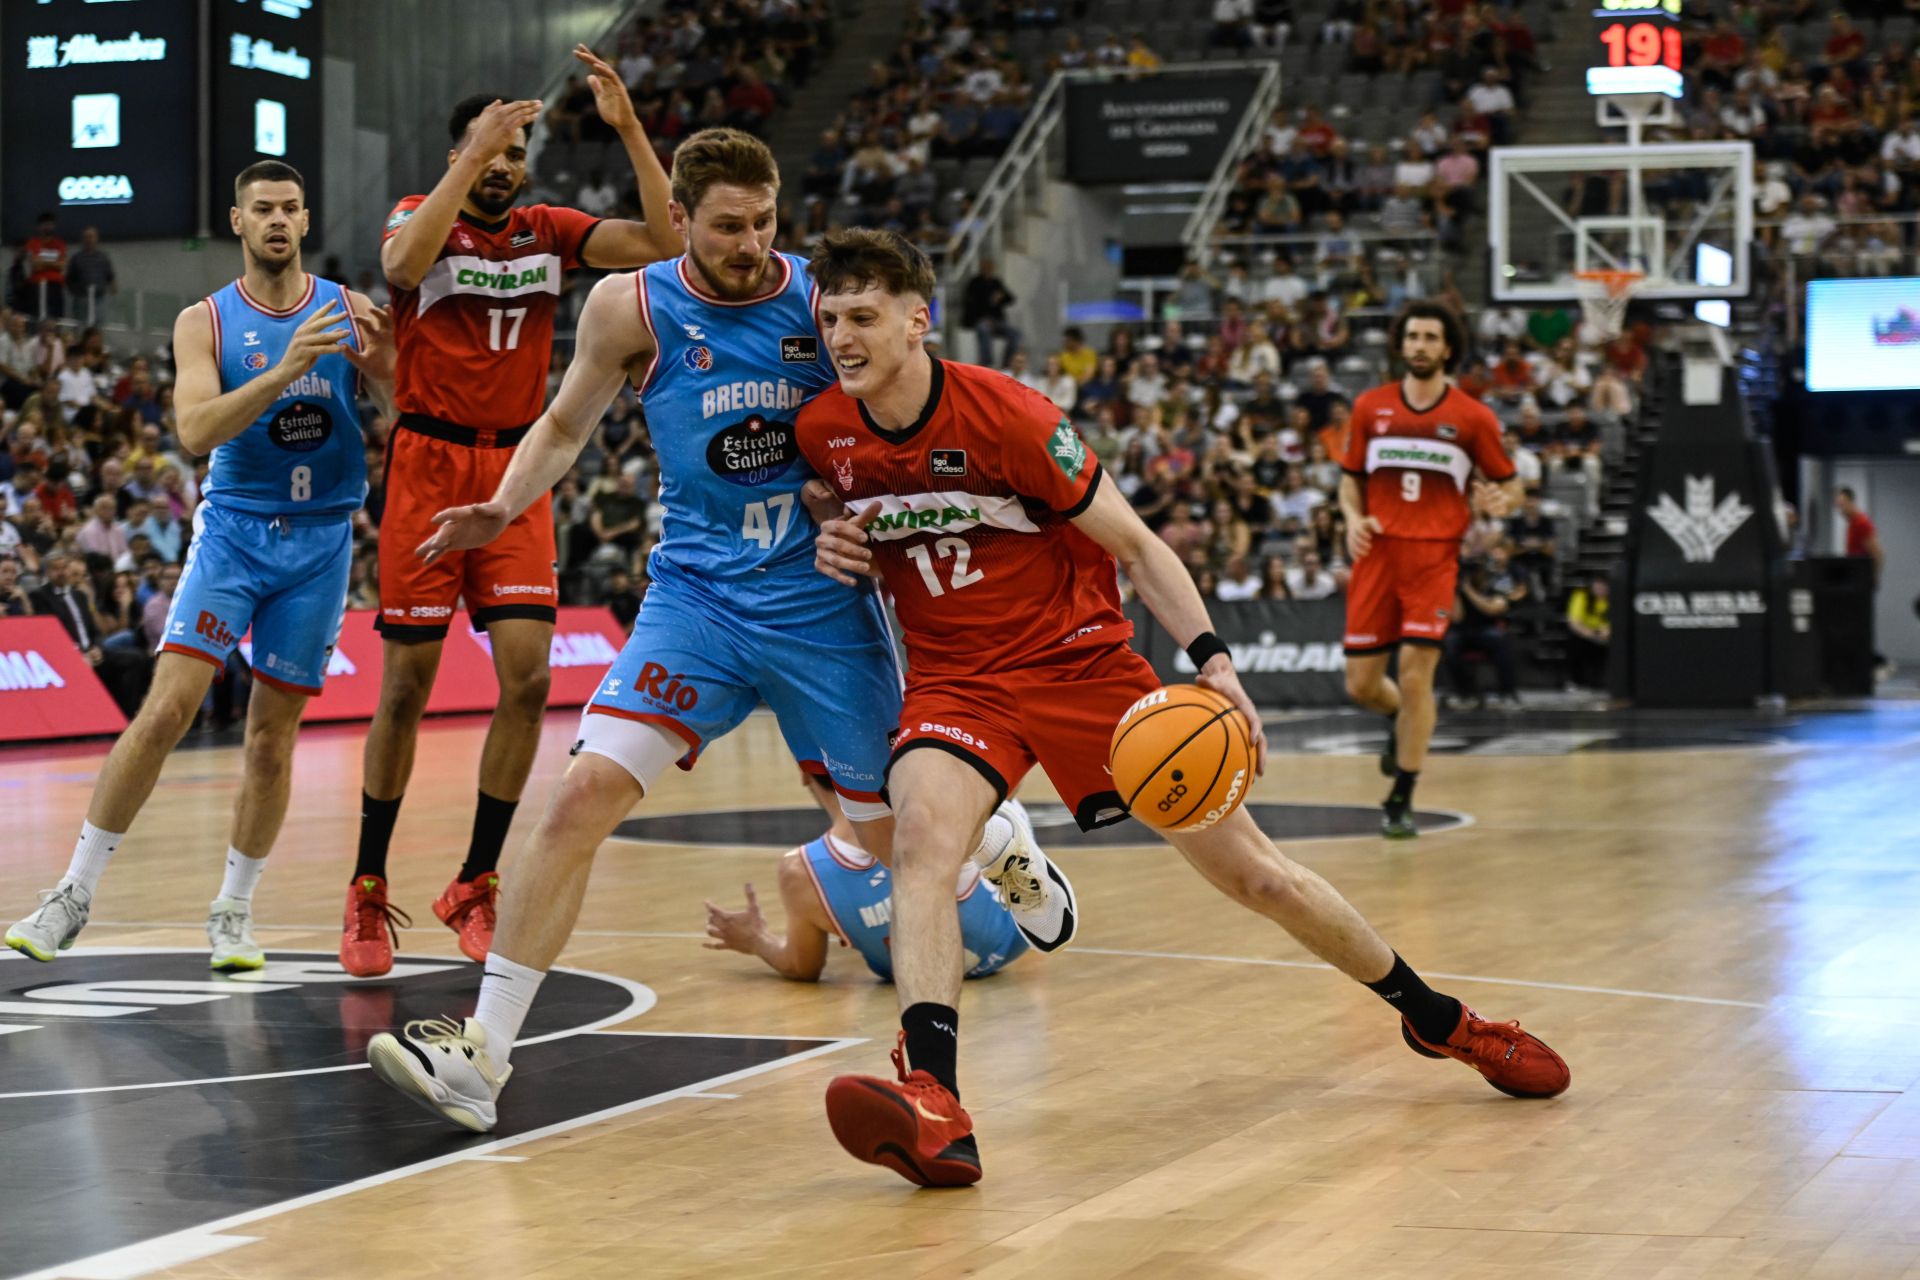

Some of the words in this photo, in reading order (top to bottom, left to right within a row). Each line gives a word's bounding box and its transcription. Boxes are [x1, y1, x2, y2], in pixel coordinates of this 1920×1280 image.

[1600, 22, 1660, 67] 19
[488, 307, 527, 351] 17
[784, 345, 799, 353] liga
[278, 372, 332, 400] EOGÁN
[702, 378, 804, 419] BREOGÁN
[279, 413, 322, 430] Estrella
[281, 427, 323, 441] Galicia
[722, 432, 786, 452] Estrella
[828, 437, 856, 448] vive
[726, 448, 784, 470] Galicia
[933, 458, 947, 466] liga
[934, 465, 963, 473] endesa
[290, 466, 312, 502] 8
[1402, 472, 1421, 501] 9
[743, 493, 794, 549] 47
[865, 502, 981, 532] OVIRAN
[906, 537, 984, 597] 12
[634, 662, 698, 711] Río
[1157, 783, 1188, 812] acb
